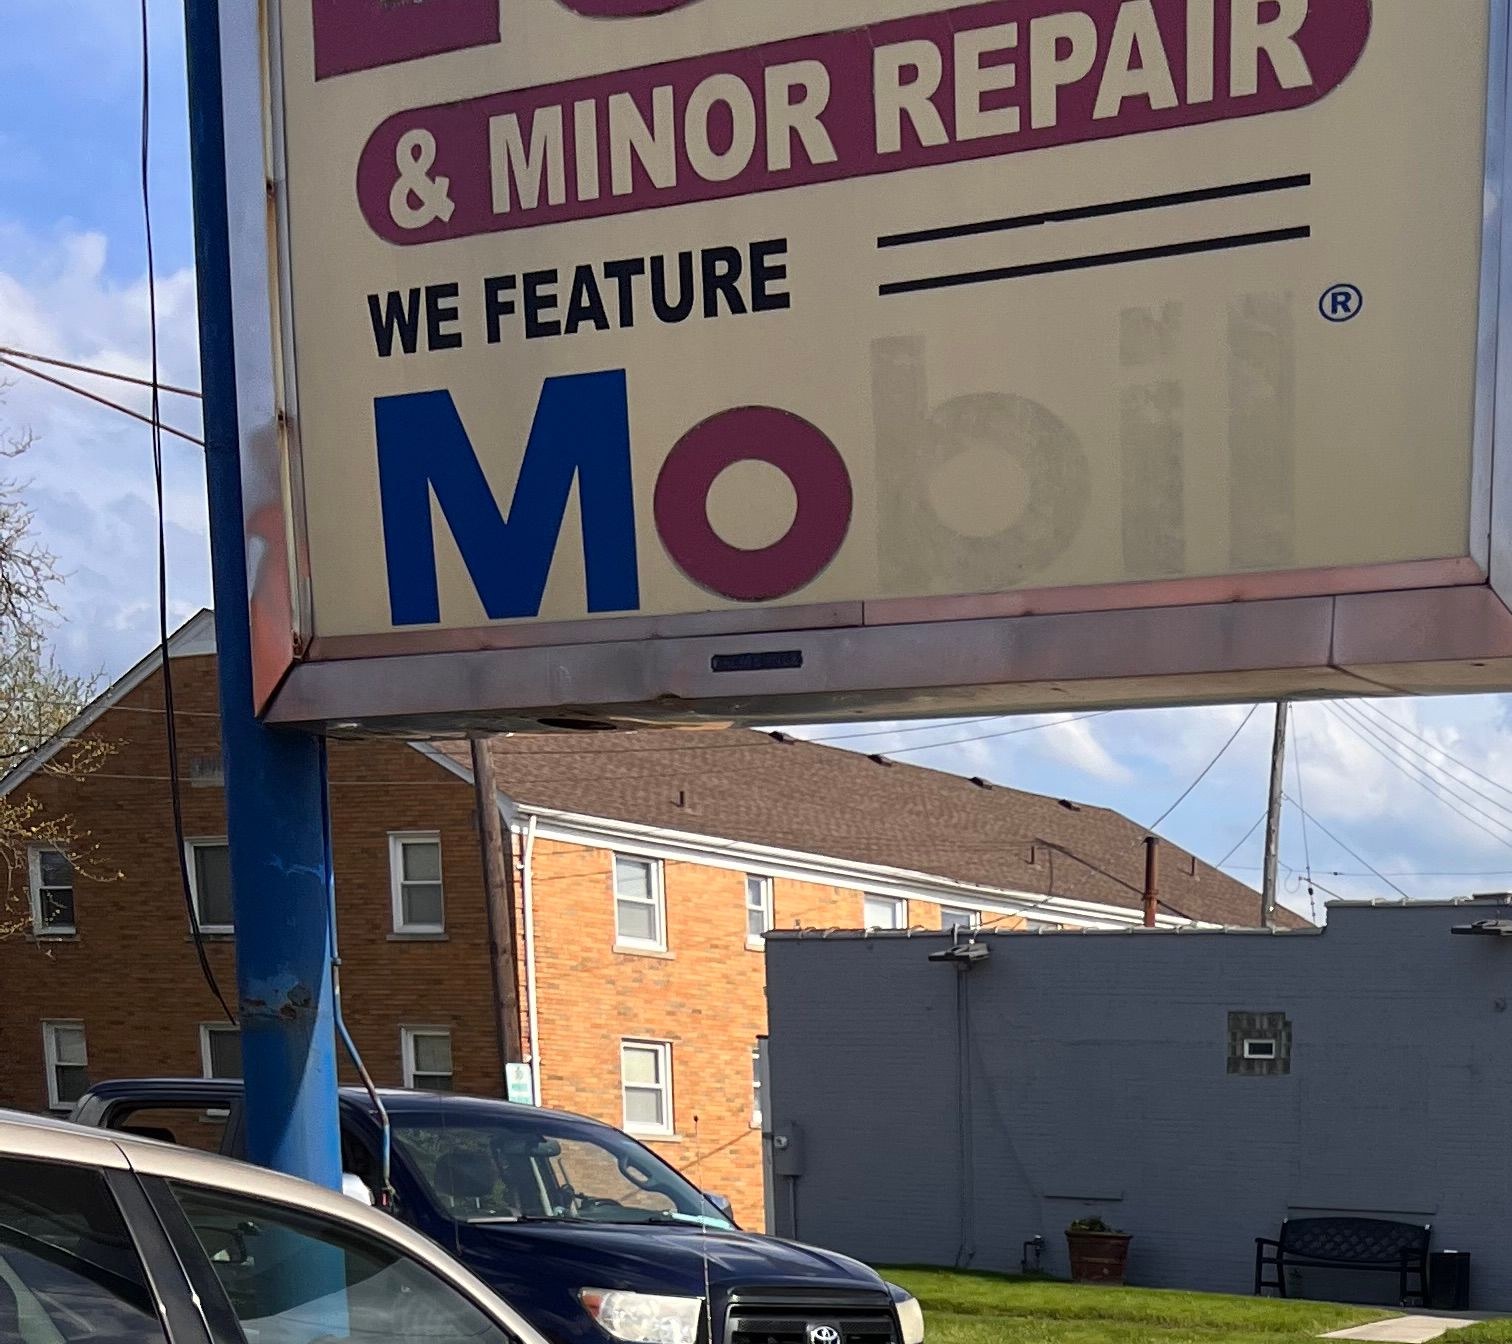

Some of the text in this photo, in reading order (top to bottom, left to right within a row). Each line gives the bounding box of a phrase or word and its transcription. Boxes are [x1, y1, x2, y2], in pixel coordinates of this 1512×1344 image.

[389, 128, 456, 230] &
[489, 59, 838, 215] MINOR
[873, 0, 1313, 154] REPAIR
[368, 238, 790, 357] WE FEATURE
